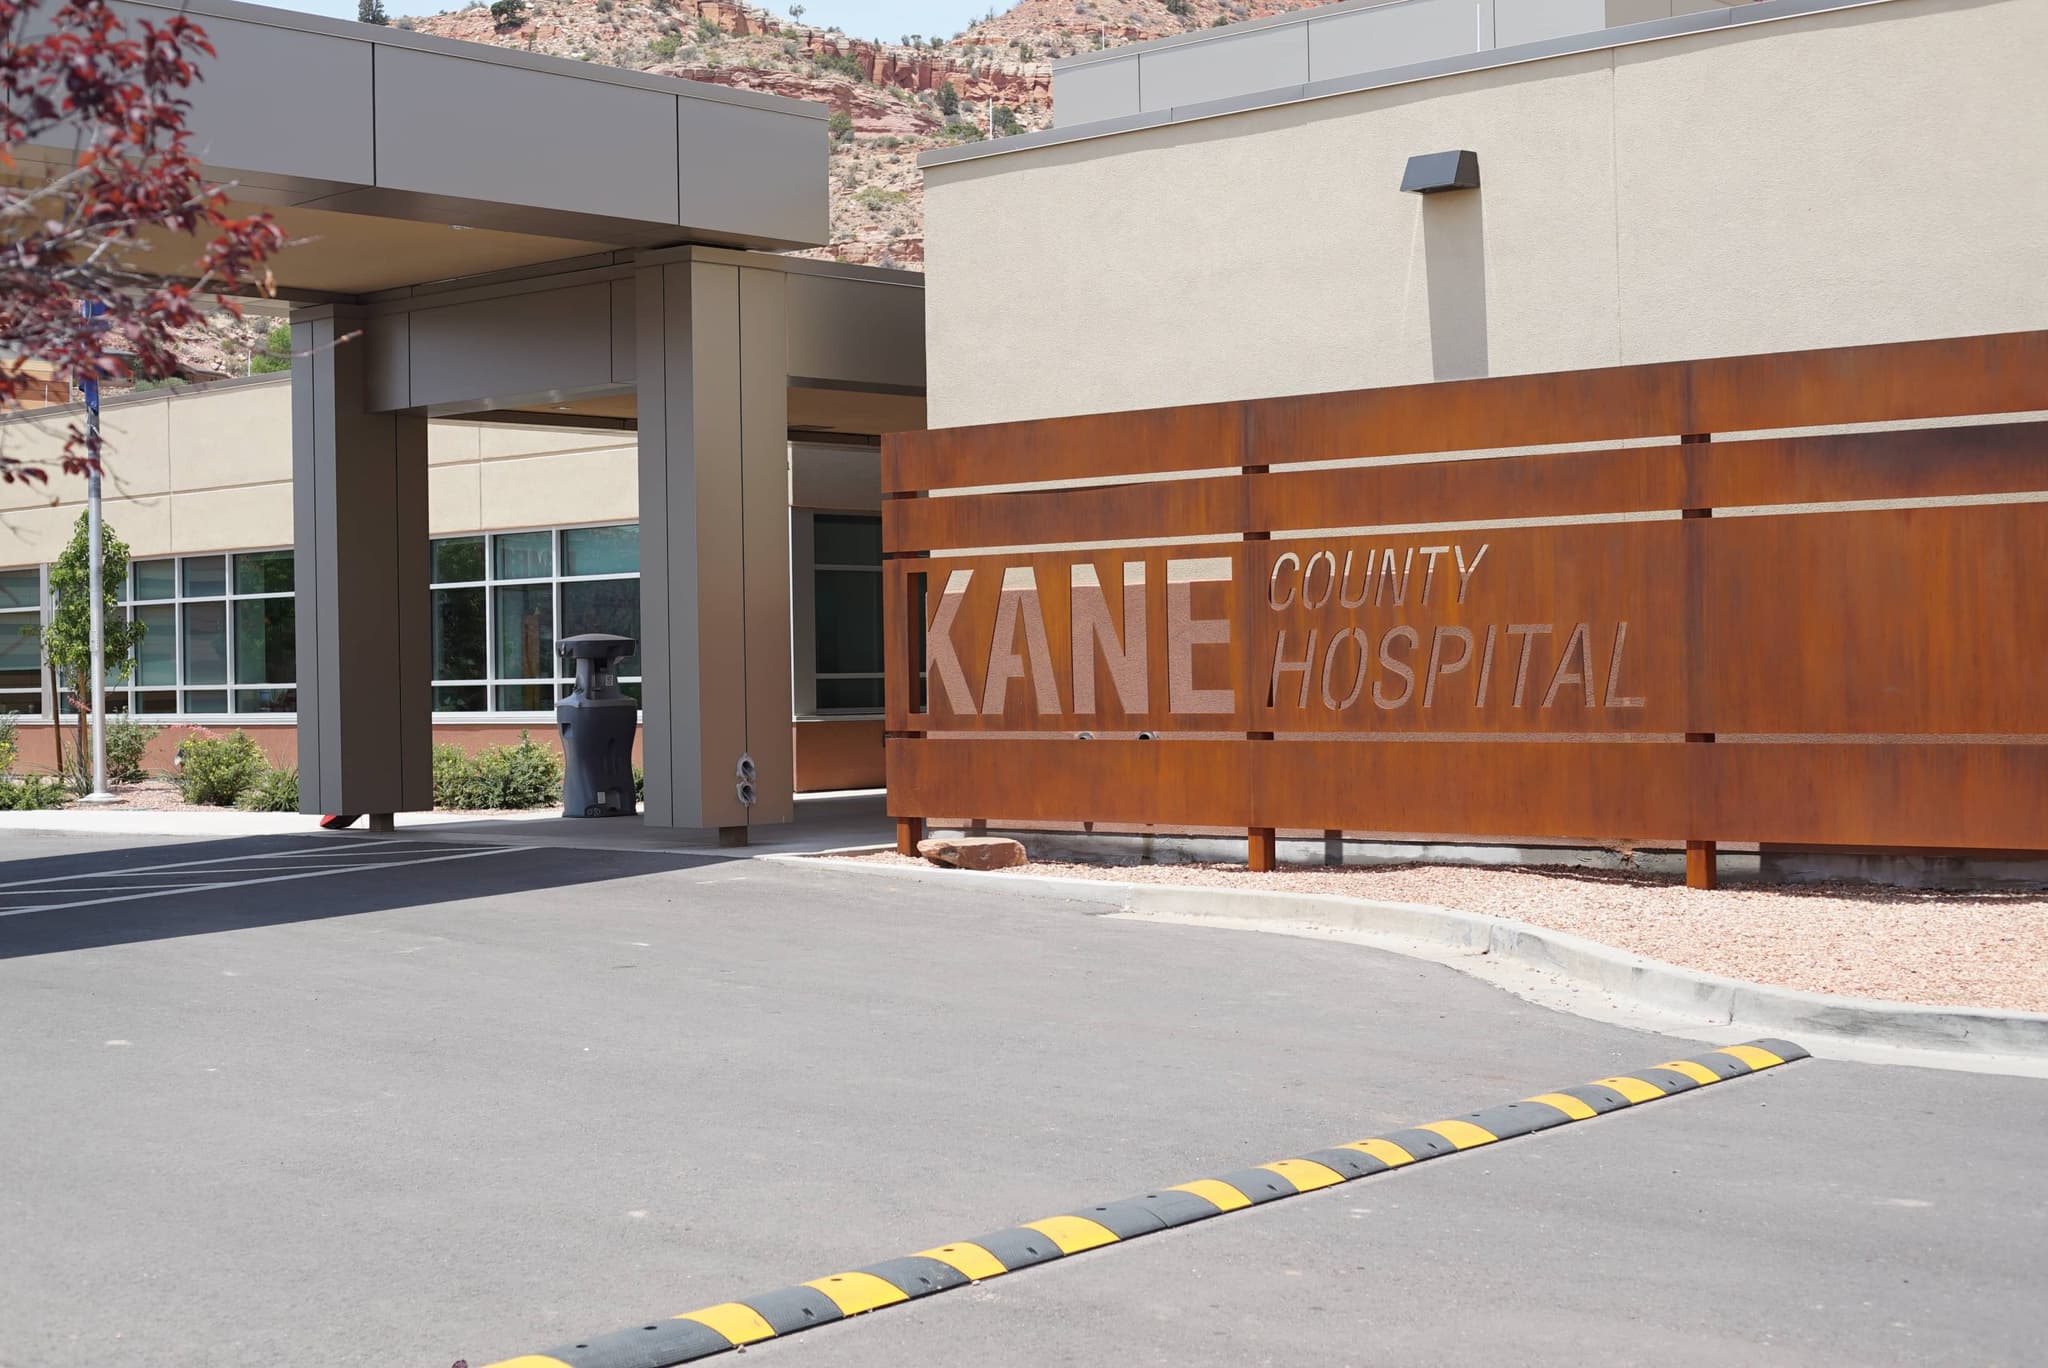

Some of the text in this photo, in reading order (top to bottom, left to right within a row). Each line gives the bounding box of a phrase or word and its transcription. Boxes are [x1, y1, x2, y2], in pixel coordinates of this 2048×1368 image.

[1269, 544, 1489, 611] COUNTY
[907, 557, 1235, 715] KANE
[1266, 621, 1646, 711] HOSPITAL
